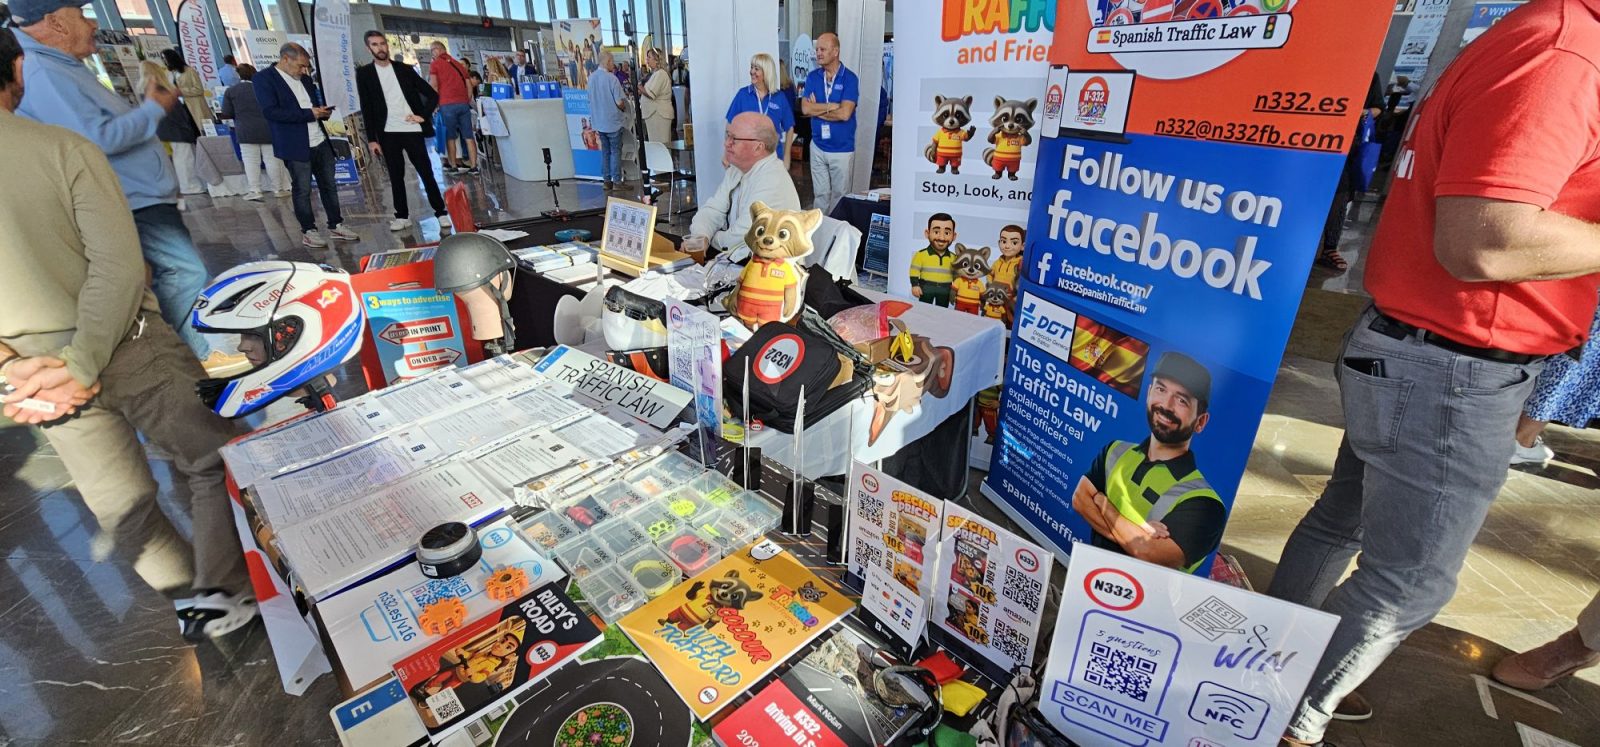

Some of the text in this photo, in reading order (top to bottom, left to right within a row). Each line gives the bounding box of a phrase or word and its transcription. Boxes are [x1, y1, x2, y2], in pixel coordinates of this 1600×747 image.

[1112, 24, 1257, 48] Spanish Traffic Law
[957, 41, 997, 65] and
[1084, 91, 1105, 102] N-332
[1254, 91, 1349, 113] n332.es
[1155, 118, 1344, 149] n332@n332fb.com
[922, 181, 959, 197] Stop,
[964, 183, 1003, 201] Look,
[1061, 144, 1283, 228] Follow us on
[1048, 189, 1272, 301] facebook
[1061, 259, 1153, 300] facebook.com/
[367, 295, 450, 309] 3 ways to advertise
[1057, 277, 1148, 314] N332SpanishTrafficLaw
[410, 327, 418, 335] IN
[419, 324, 442, 335] PRINT
[1036, 316, 1072, 340] DGT
[764, 347, 794, 370] N332
[556, 364, 619, 401] TRAFFIC
[617, 391, 664, 418] LAW
[583, 359, 658, 396] SPANISH
[1015, 344, 1119, 419] The Spanish
[1011, 364, 1102, 433] Traffic Law
[1006, 399, 1032, 421] police
[1033, 416, 1069, 446] officers
[1008, 387, 1084, 442] explained by real
[1027, 427, 1040, 441] Page
[1040, 437, 1067, 460] dedicated
[1031, 458, 1068, 490] understanding
[1063, 472, 1069, 481] to
[891, 490, 938, 518] SPECIAL
[1045, 485, 1070, 509] informed
[897, 501, 930, 522] PRICE
[859, 526, 880, 540] amazon
[947, 515, 998, 546] SPECIAL
[953, 528, 989, 551] PRICE
[1020, 553, 1035, 567] N332
[974, 582, 996, 604] 10€
[1093, 579, 1131, 600] N332
[378, 591, 417, 642] n332.es/v16
[519, 598, 555, 634] ROAD
[536, 589, 579, 630] RILEY'S
[1003, 606, 1031, 627] amazon
[1211, 603, 1238, 621] TEST
[684, 624, 737, 658] WITH
[717, 607, 772, 665] COLOUR
[969, 626, 990, 646] 10€
[1096, 629, 1161, 657] 5 questions
[1247, 624, 1269, 648] &
[535, 646, 551, 661] N332
[654, 623, 742, 686] TRAFFORD
[1213, 644, 1299, 674] WIN
[351, 699, 373, 719] E
[793, 709, 821, 736] N332
[806, 694, 843, 731] Mark Nolan
[1062, 689, 1157, 734] SCAN ME
[1205, 708, 1245, 729] NFC
[764, 701, 799, 736] Driving
[792, 730, 808, 747] in
[736, 729, 760, 747] 202
